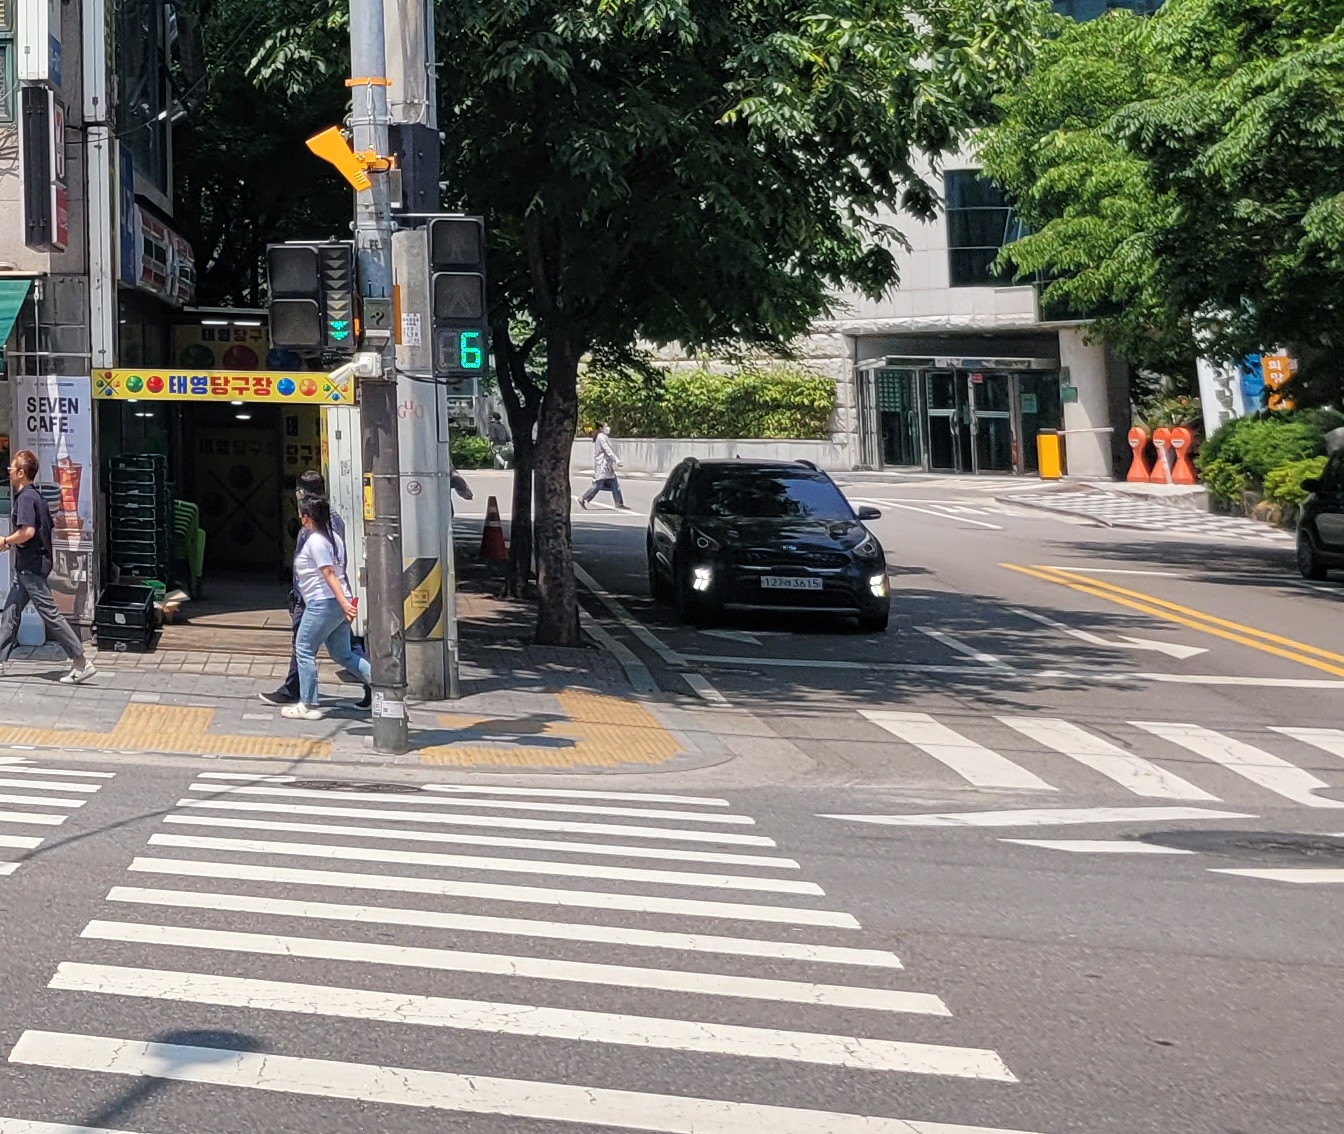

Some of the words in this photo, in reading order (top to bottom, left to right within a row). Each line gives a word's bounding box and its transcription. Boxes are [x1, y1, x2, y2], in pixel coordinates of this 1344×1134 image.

[460, 331, 482, 369] 6
[168, 376, 273, 397] 태영당구장
[26, 396, 79, 415] SEVEN
